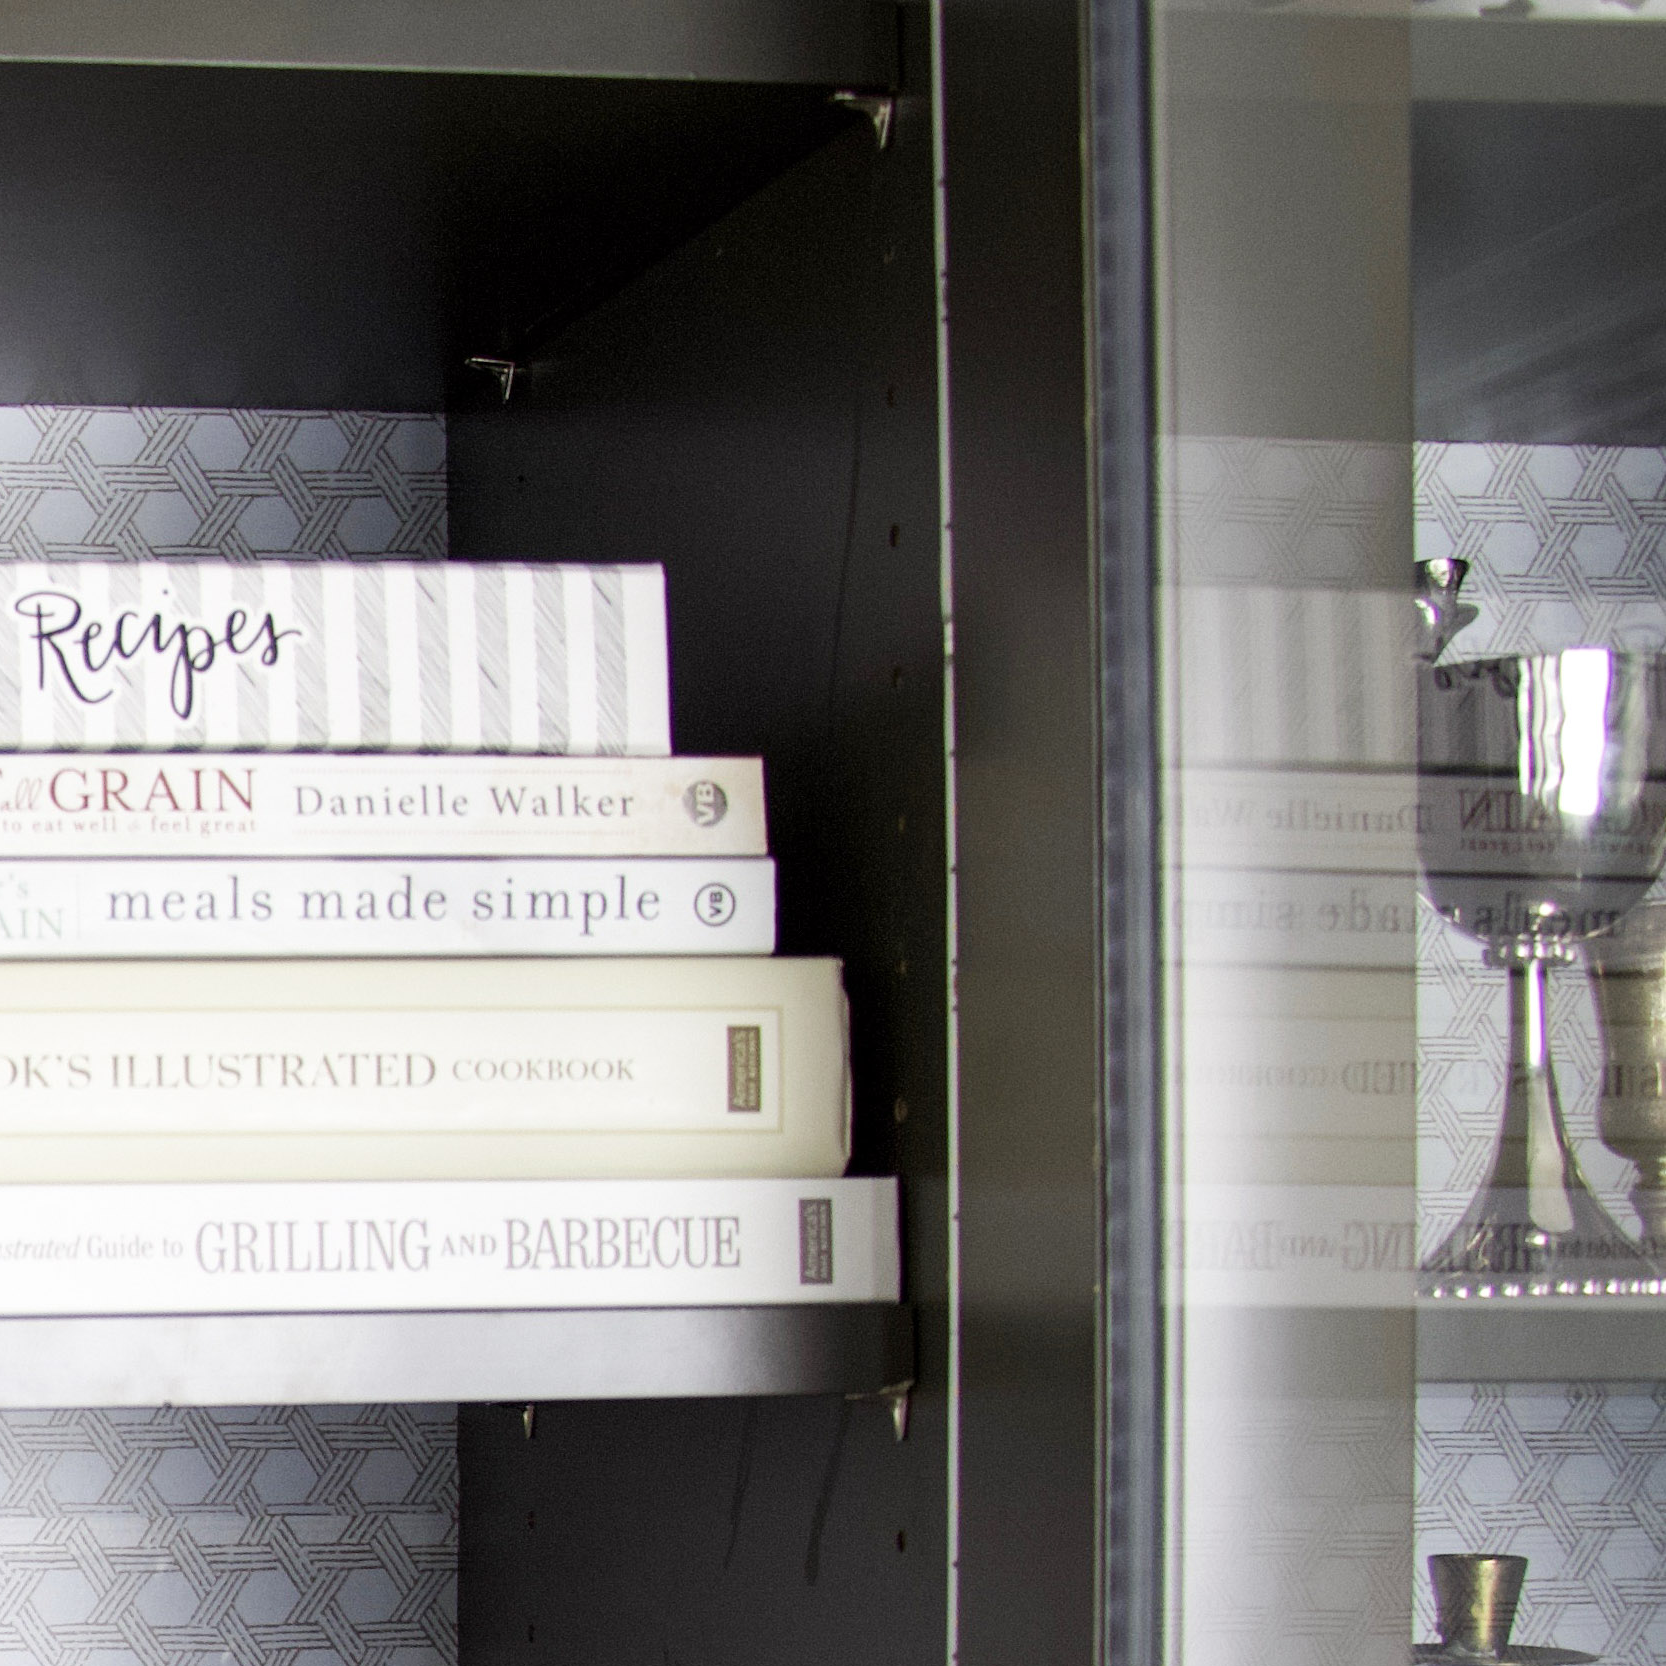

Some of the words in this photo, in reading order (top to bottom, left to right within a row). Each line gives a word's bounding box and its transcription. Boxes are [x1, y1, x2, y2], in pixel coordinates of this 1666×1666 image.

[14, 588, 303, 720] Recipes
[0, 776, 44, 812] all
[47, 767, 257, 814] GRAIN
[293, 784, 469, 817] Danielle
[489, 785, 635, 818] Walker
[1, 817, 23, 835] to
[31, 818, 65, 836] eat
[72, 815, 118, 836] well
[149, 814, 192, 836] feel
[199, 817, 259, 841] great
[104, 875, 273, 922] meals
[298, 874, 449, 922] made
[471, 874, 662, 936] simple
[707, 889, 724, 918] VB
[110, 1052, 437, 1091] ILLUSTRATED
[451, 1059, 637, 1084] COOKBOOK
[85, 1235, 155, 1260] Guide
[162, 1237, 185, 1259] to
[193, 1219, 431, 1274] GRILLING
[440, 1233, 498, 1258] AND
[504, 1215, 742, 1271] BARBECUE
